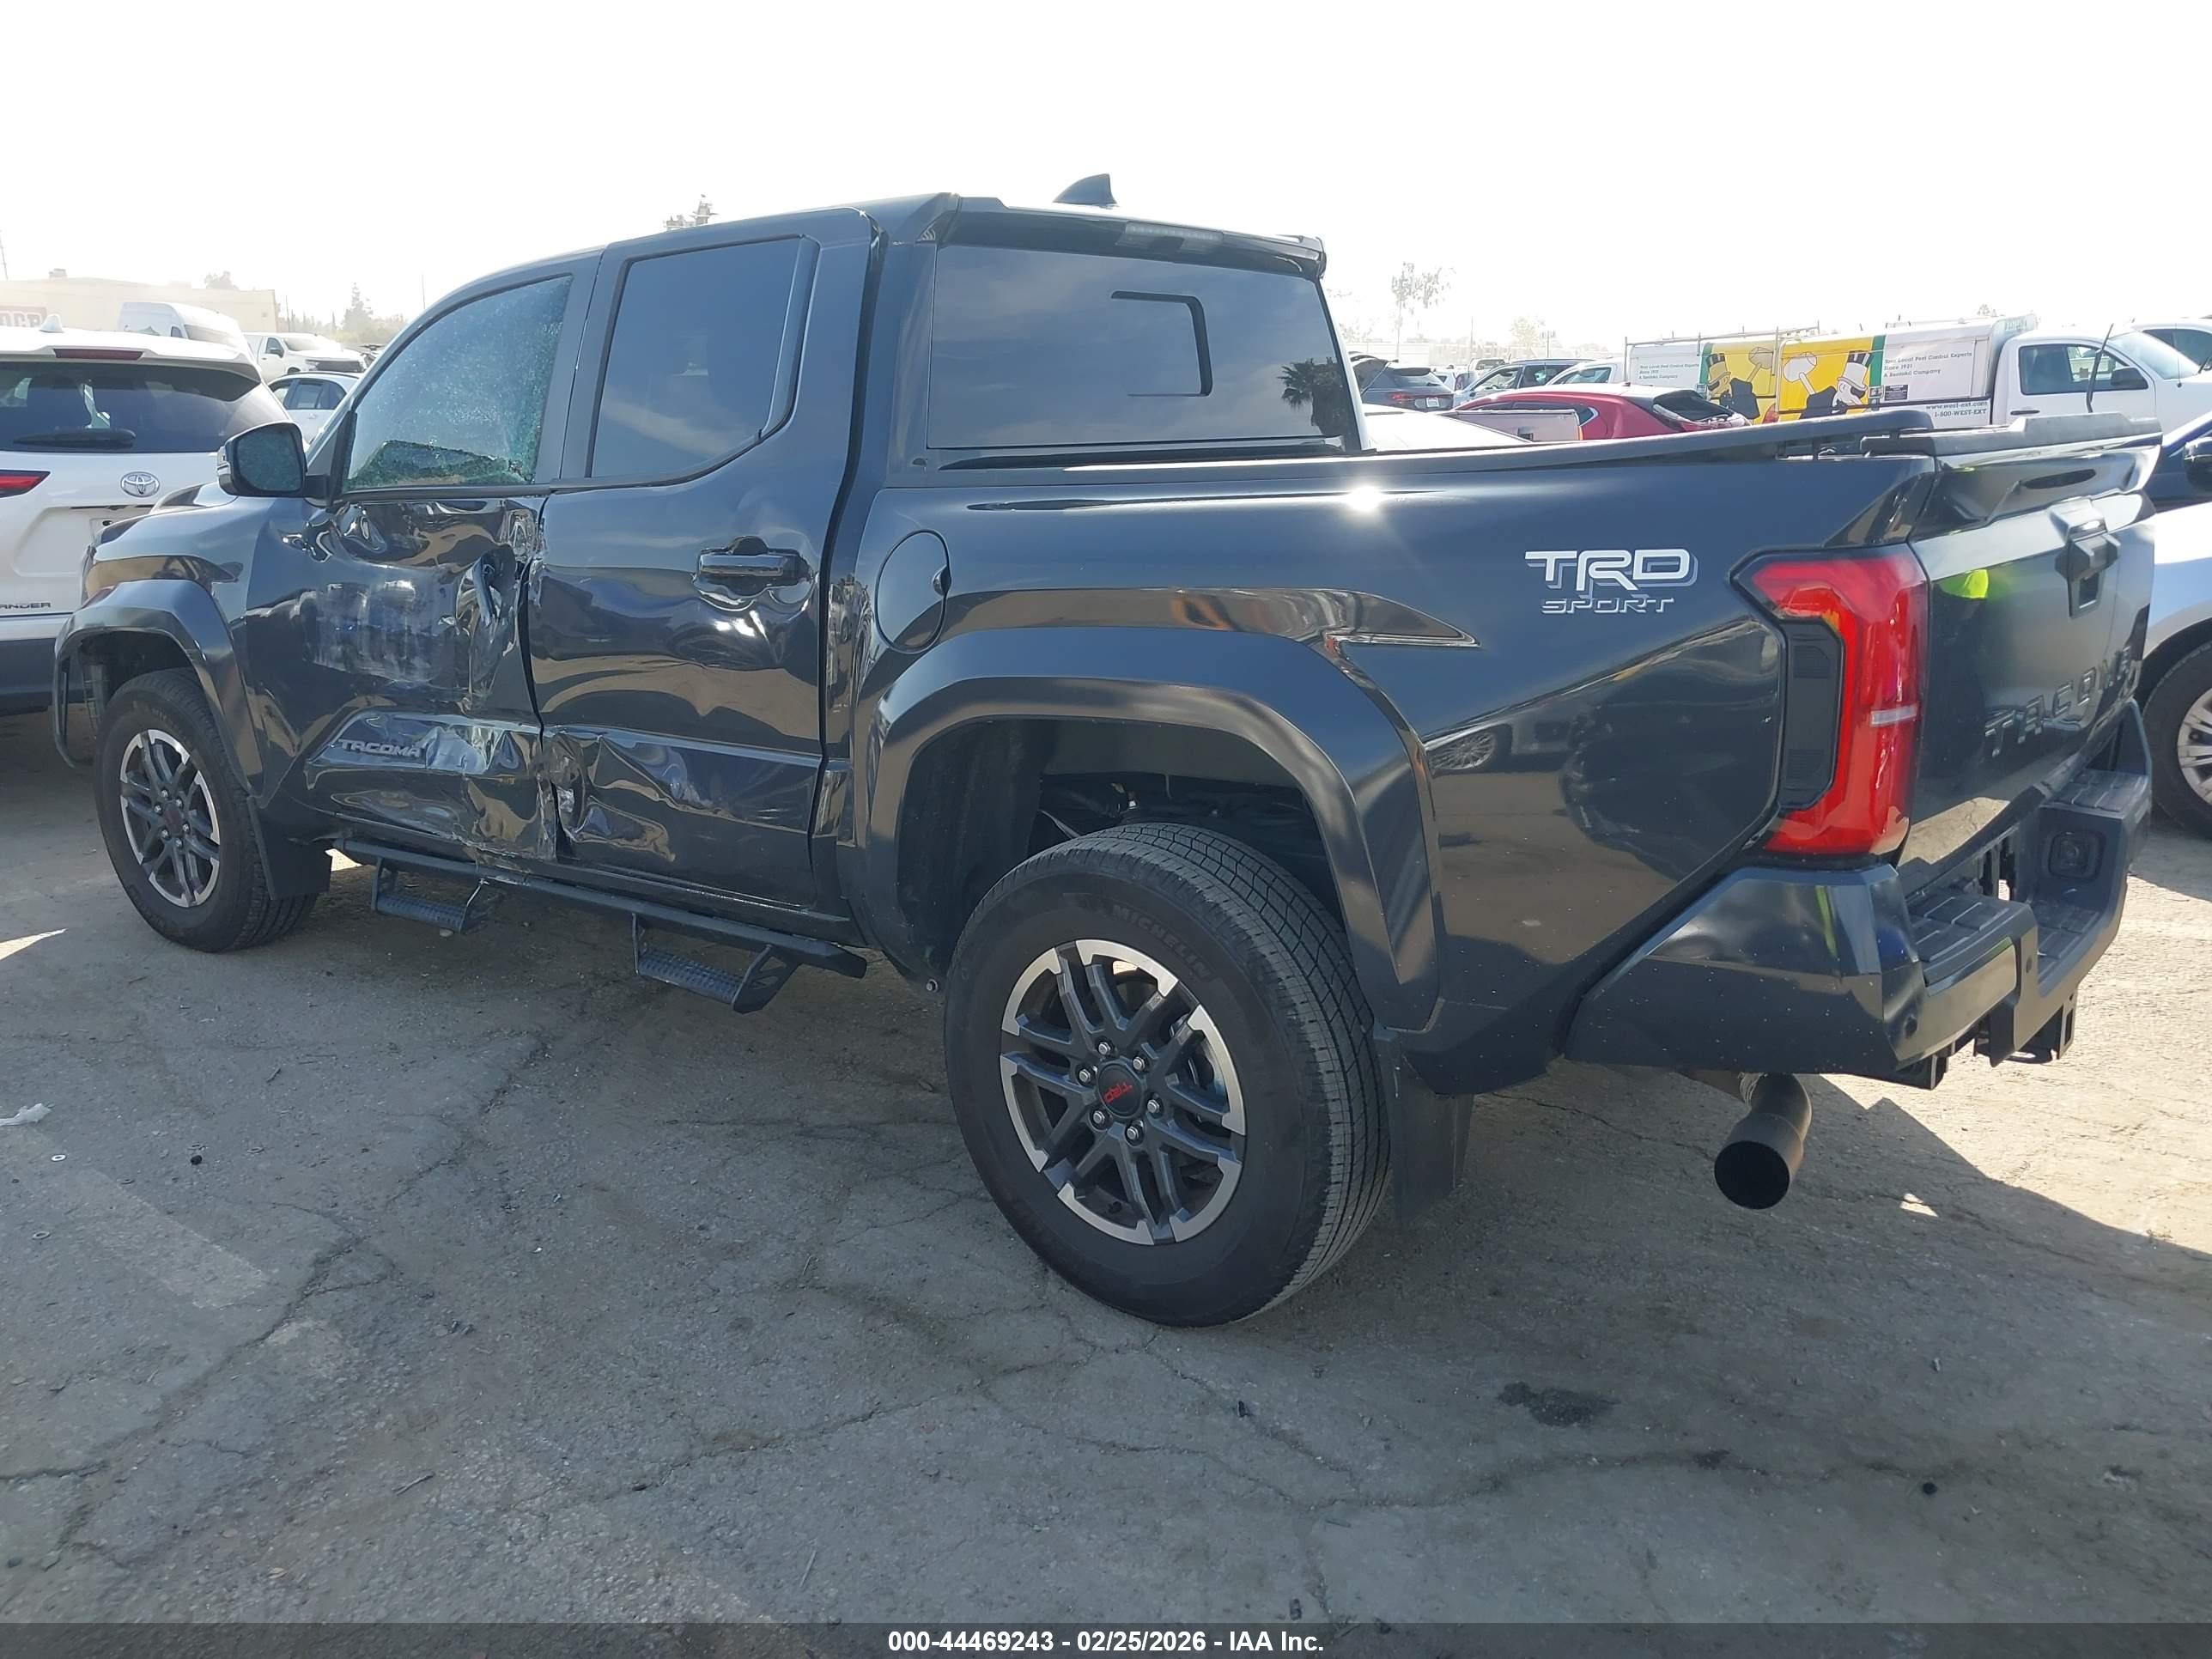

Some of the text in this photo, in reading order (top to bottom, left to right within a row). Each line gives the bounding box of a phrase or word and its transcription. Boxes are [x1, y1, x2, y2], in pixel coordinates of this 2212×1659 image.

[1525, 549, 1698, 592] TRD
[1541, 598, 1674, 614] SPORT
[338, 738, 421, 758] TACOMA
[1112, 903, 1214, 981] MICHELIN
